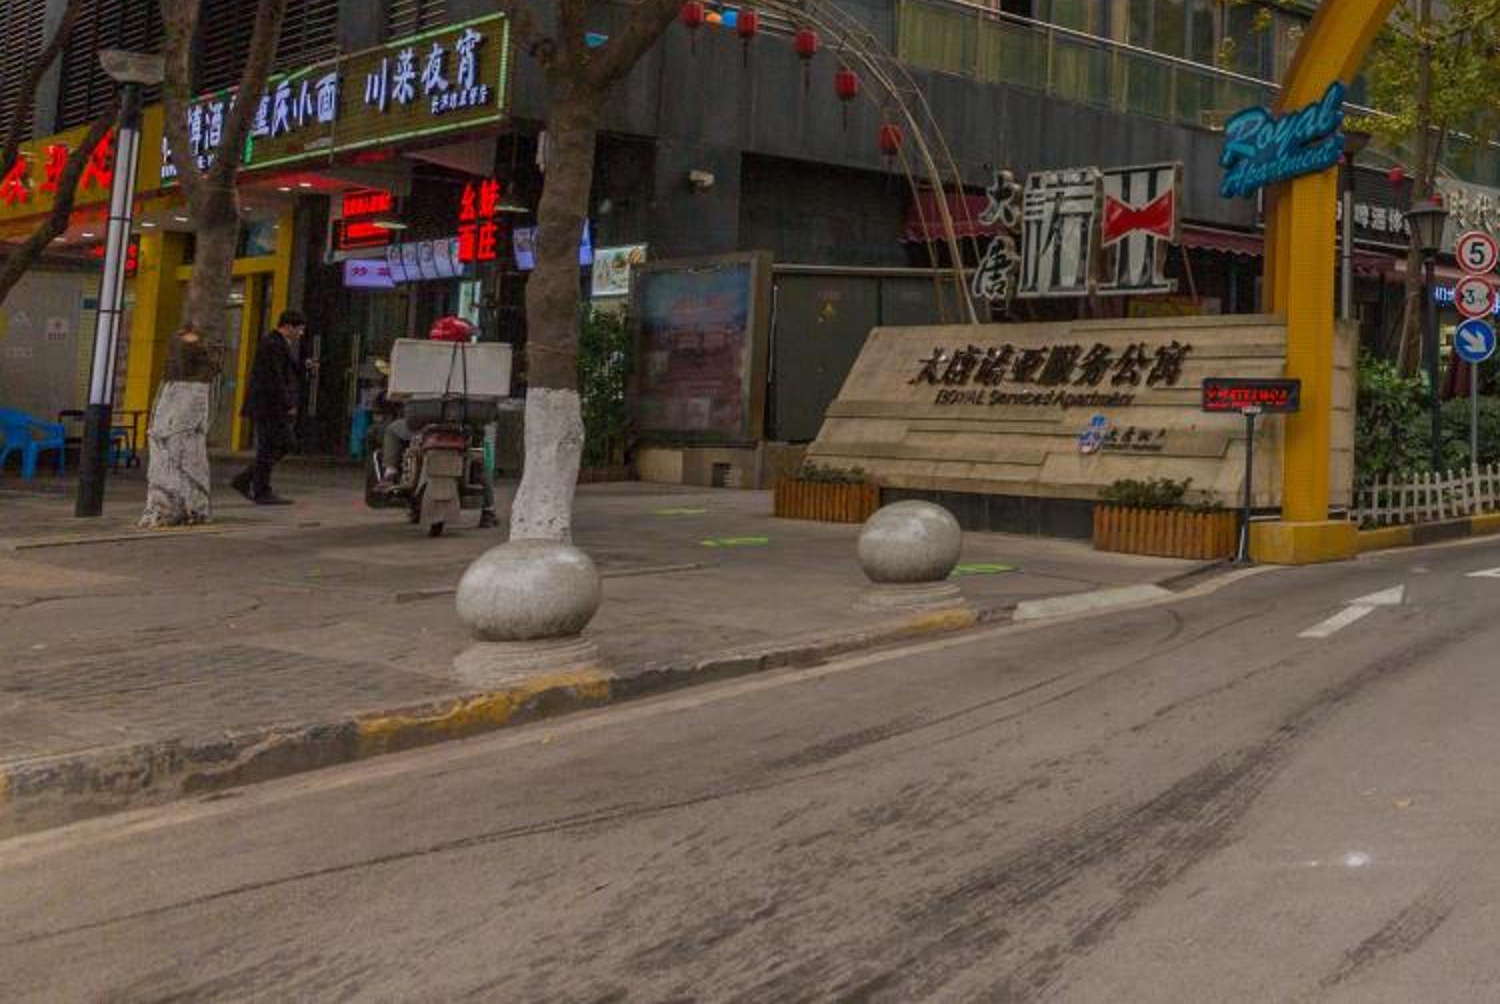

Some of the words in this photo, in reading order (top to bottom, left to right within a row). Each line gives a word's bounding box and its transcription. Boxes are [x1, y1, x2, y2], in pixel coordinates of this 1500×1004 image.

[364, 28, 481, 112] 川菜夜宵
[1221, 79, 1345, 167] Royal
[1469, 242, 1484, 265] 5
[907, 341, 1194, 387] 大唐诺亚服务公寓
